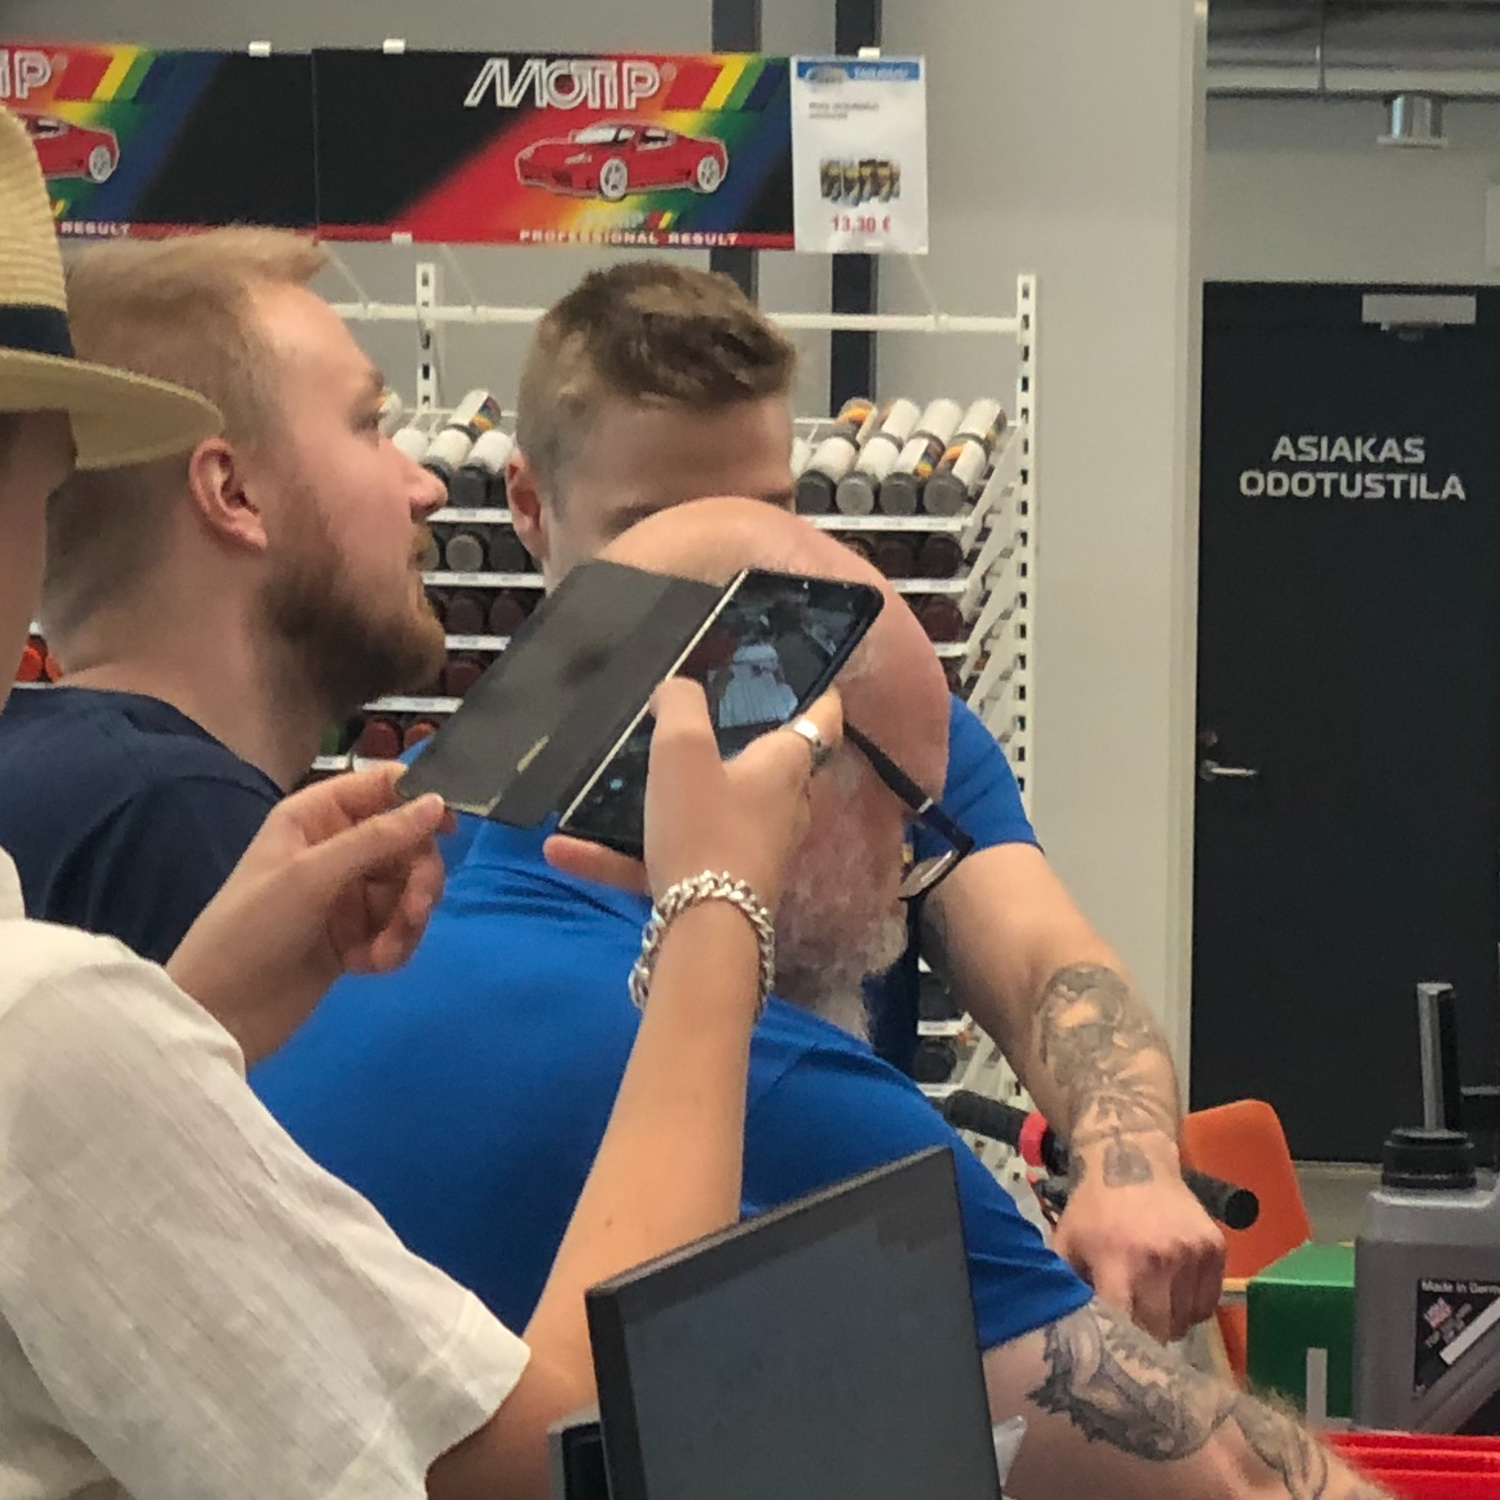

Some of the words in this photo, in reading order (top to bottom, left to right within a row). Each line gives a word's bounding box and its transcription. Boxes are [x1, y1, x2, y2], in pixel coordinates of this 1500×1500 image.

[463, 57, 660, 110] MOTIP
[519, 228, 658, 246] PROFESSIONAL
[668, 231, 738, 247] RESULT
[1271, 434, 1426, 464] ASIAKAS
[1239, 470, 1466, 500] ODOTUSTILA
[1421, 1280, 1453, 1293] Made
[1456, 1281, 1467, 1293] in
